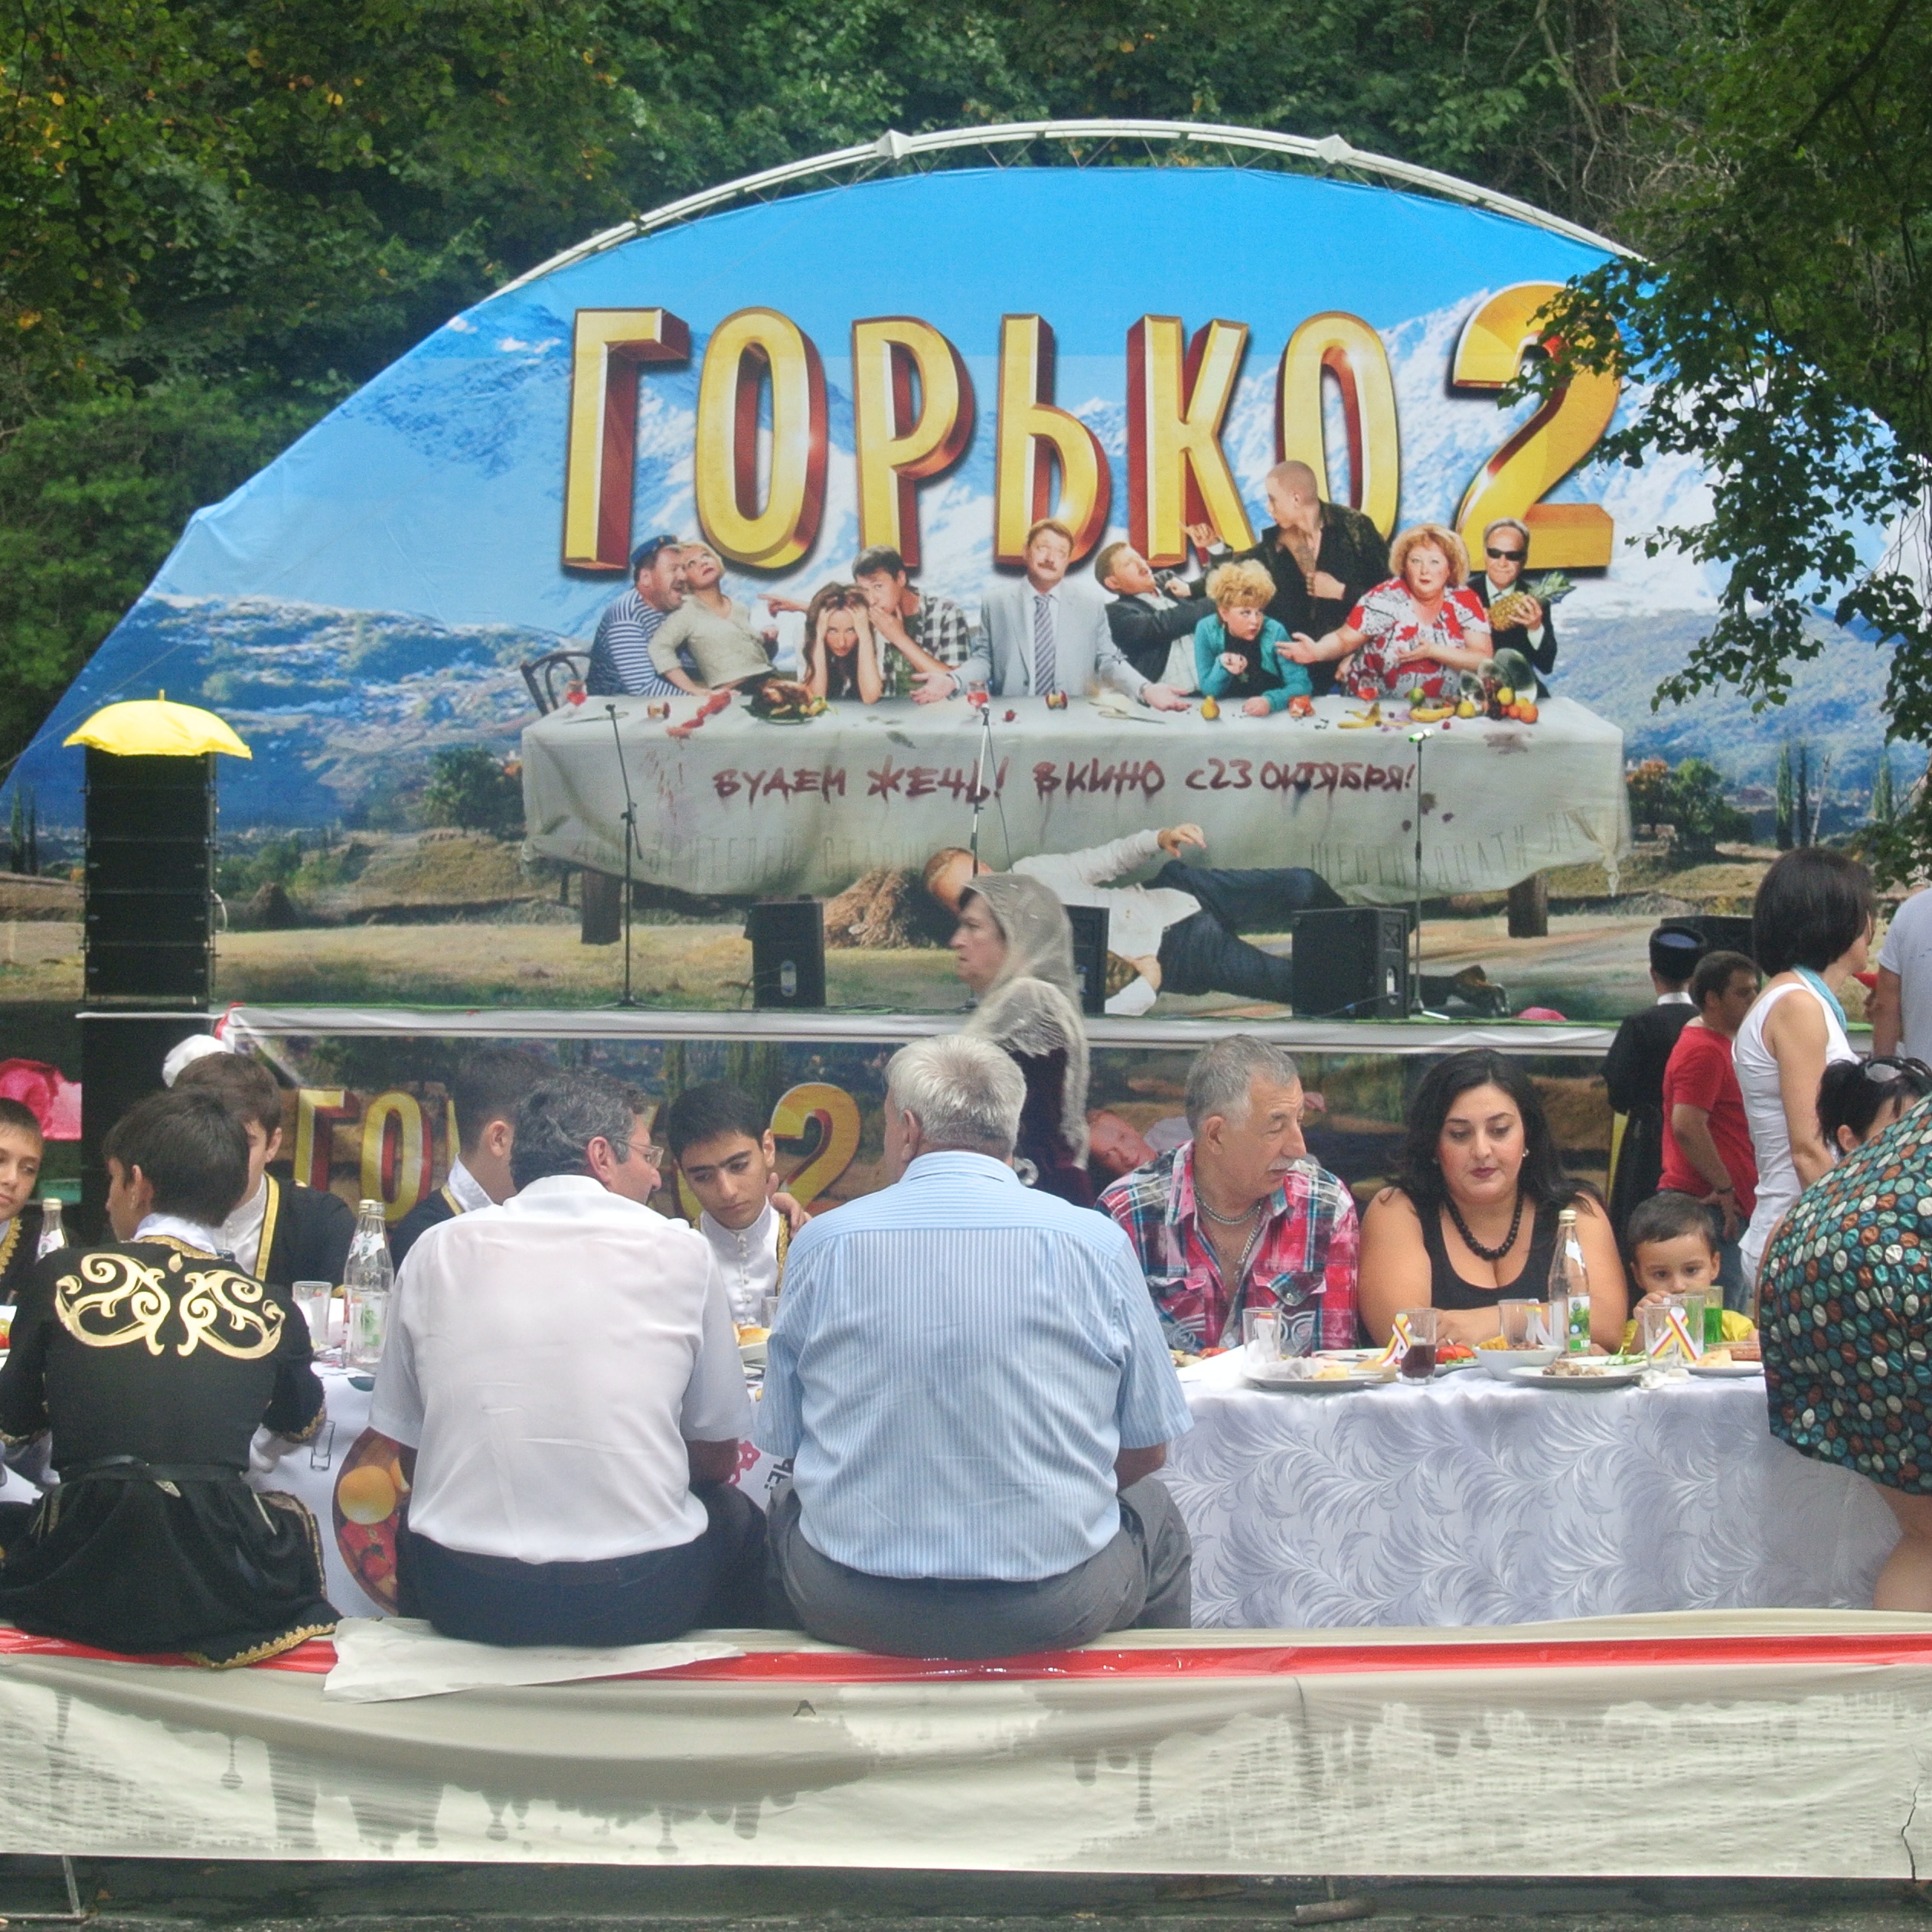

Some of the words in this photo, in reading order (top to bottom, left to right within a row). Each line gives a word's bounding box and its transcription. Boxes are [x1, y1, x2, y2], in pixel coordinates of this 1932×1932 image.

[561, 306, 1400, 573] ГОРЬКО
[1453, 280, 1622, 571] 2
[712, 767, 846, 804] БУДЕМ
